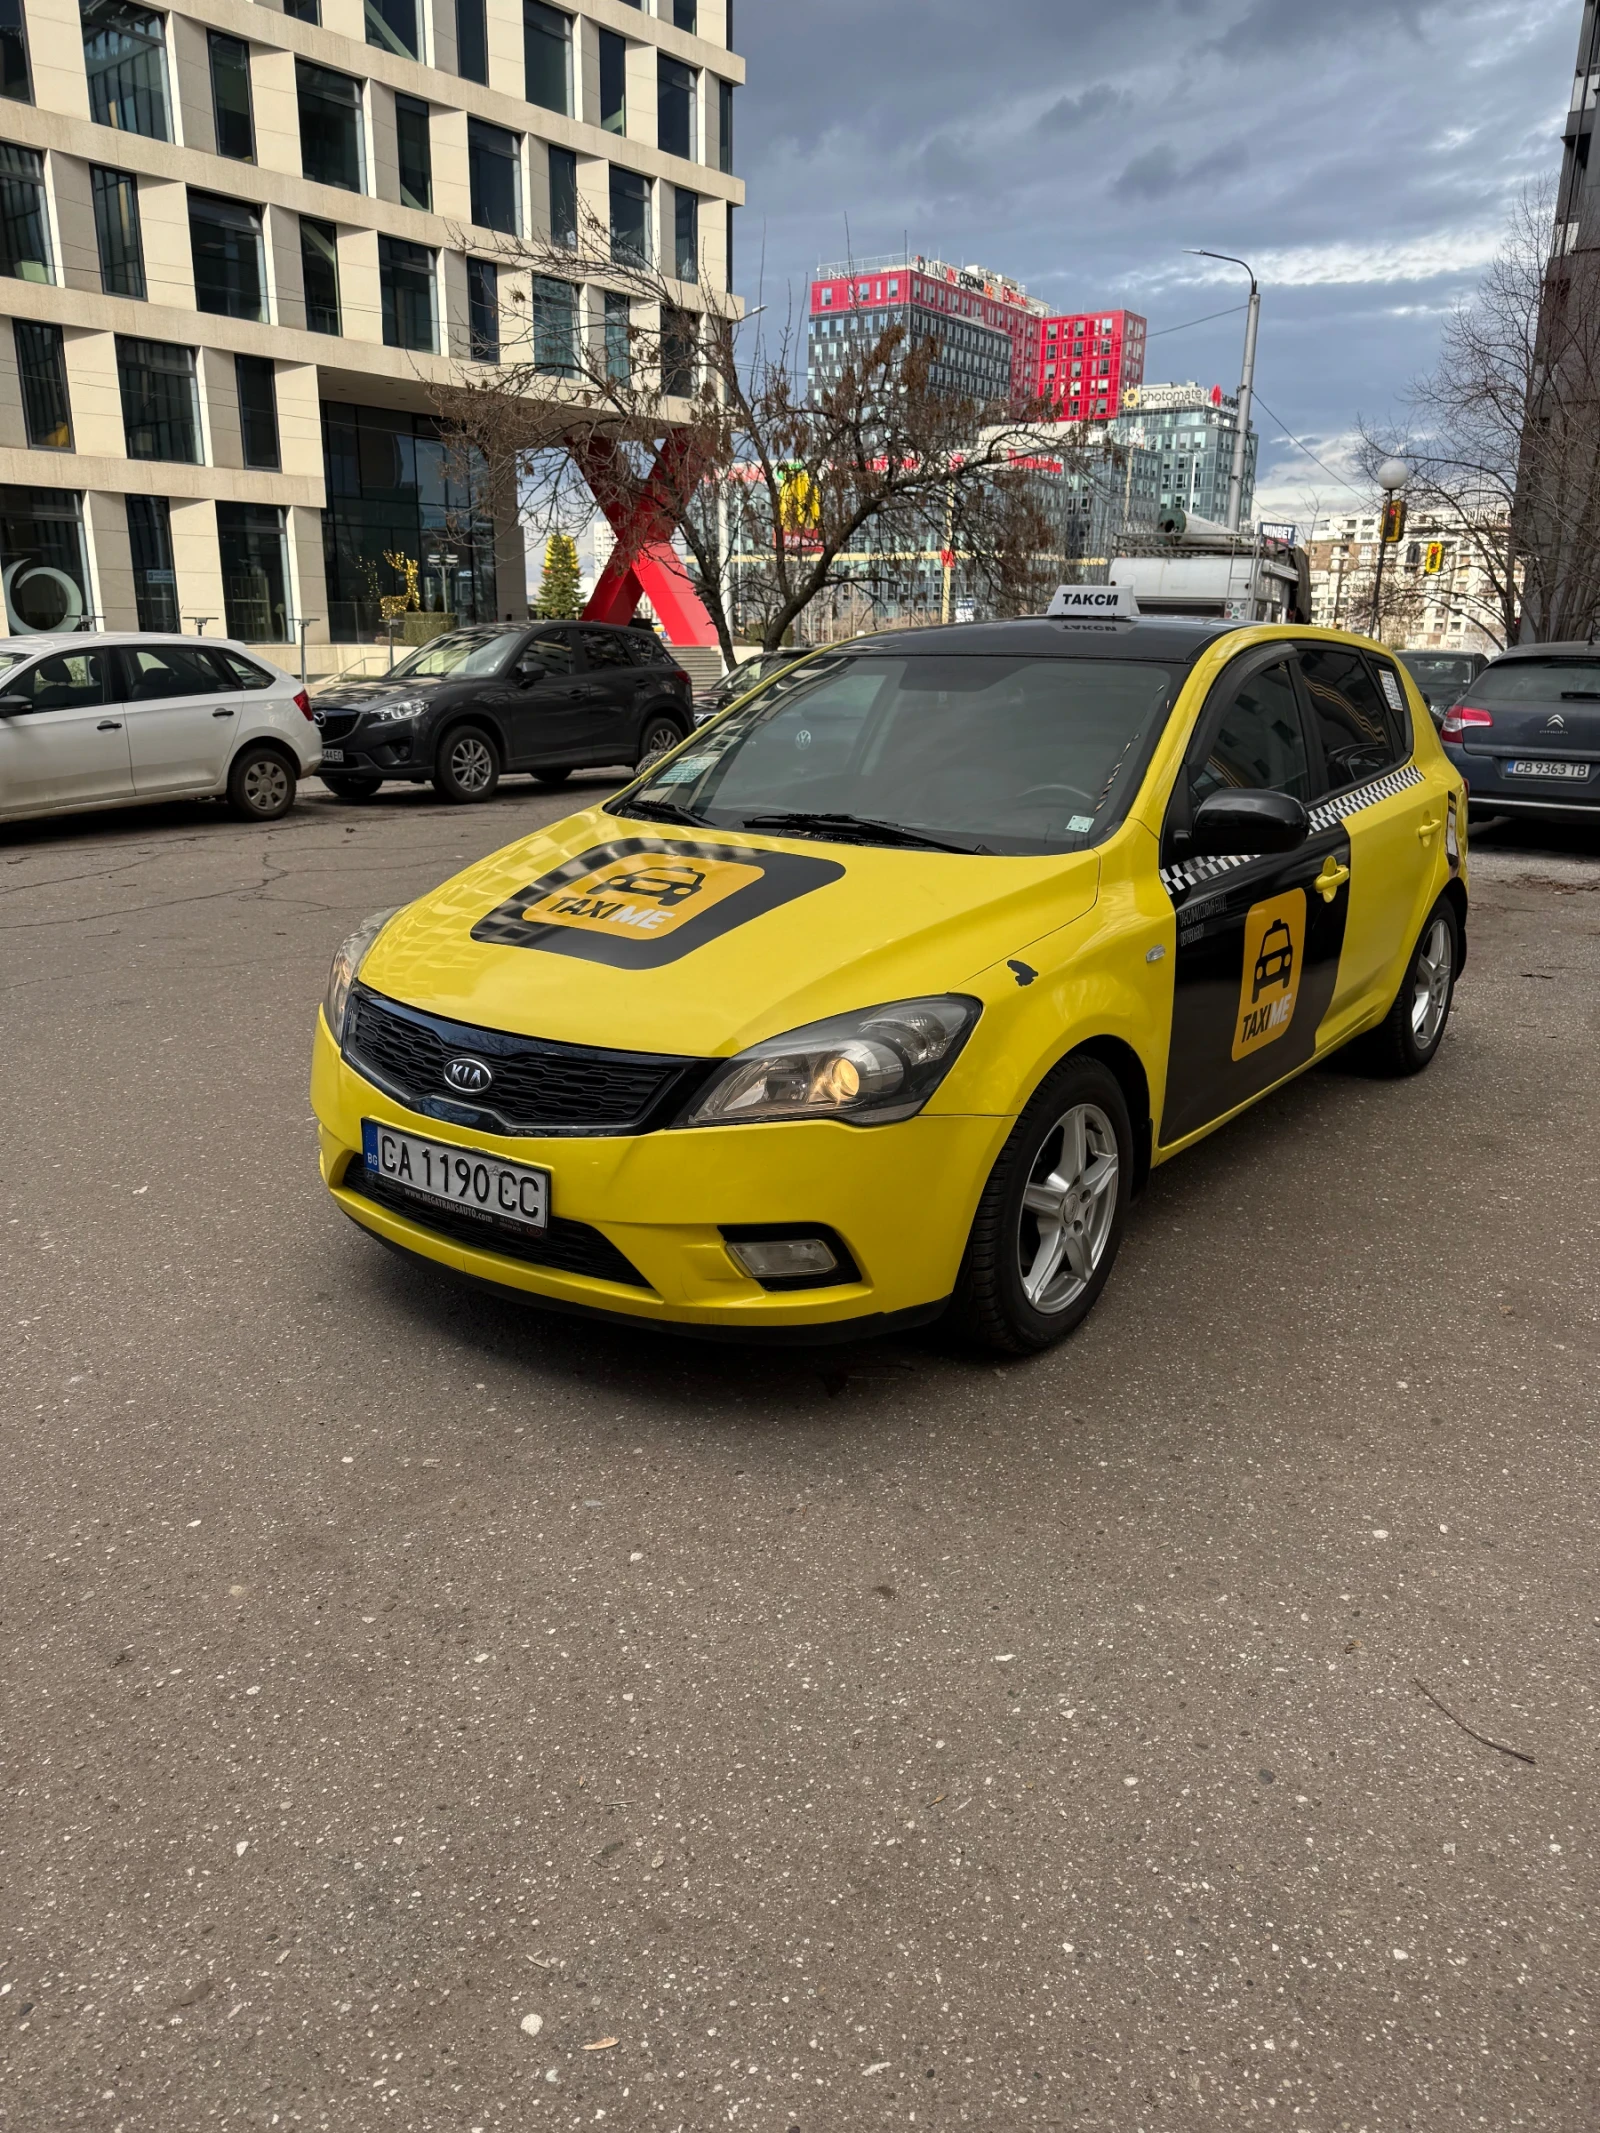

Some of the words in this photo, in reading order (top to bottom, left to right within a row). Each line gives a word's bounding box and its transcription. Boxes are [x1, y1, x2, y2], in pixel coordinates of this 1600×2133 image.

[1140, 388, 1202, 405] photomate
[1262, 524, 1293, 539] WINBET
[1062, 593, 1119, 606] ТАКСИ
[1515, 762, 1533, 773] CB
[1535, 763, 1567, 775] 9363
[1570, 764, 1587, 777] TB
[450, 1063, 482, 1087] KIA
[367, 1152, 378, 1166] BG
[421, 1147, 490, 1203] 1190
[404, 1187, 493, 1223] www.MEGATRANSAUTO.com
